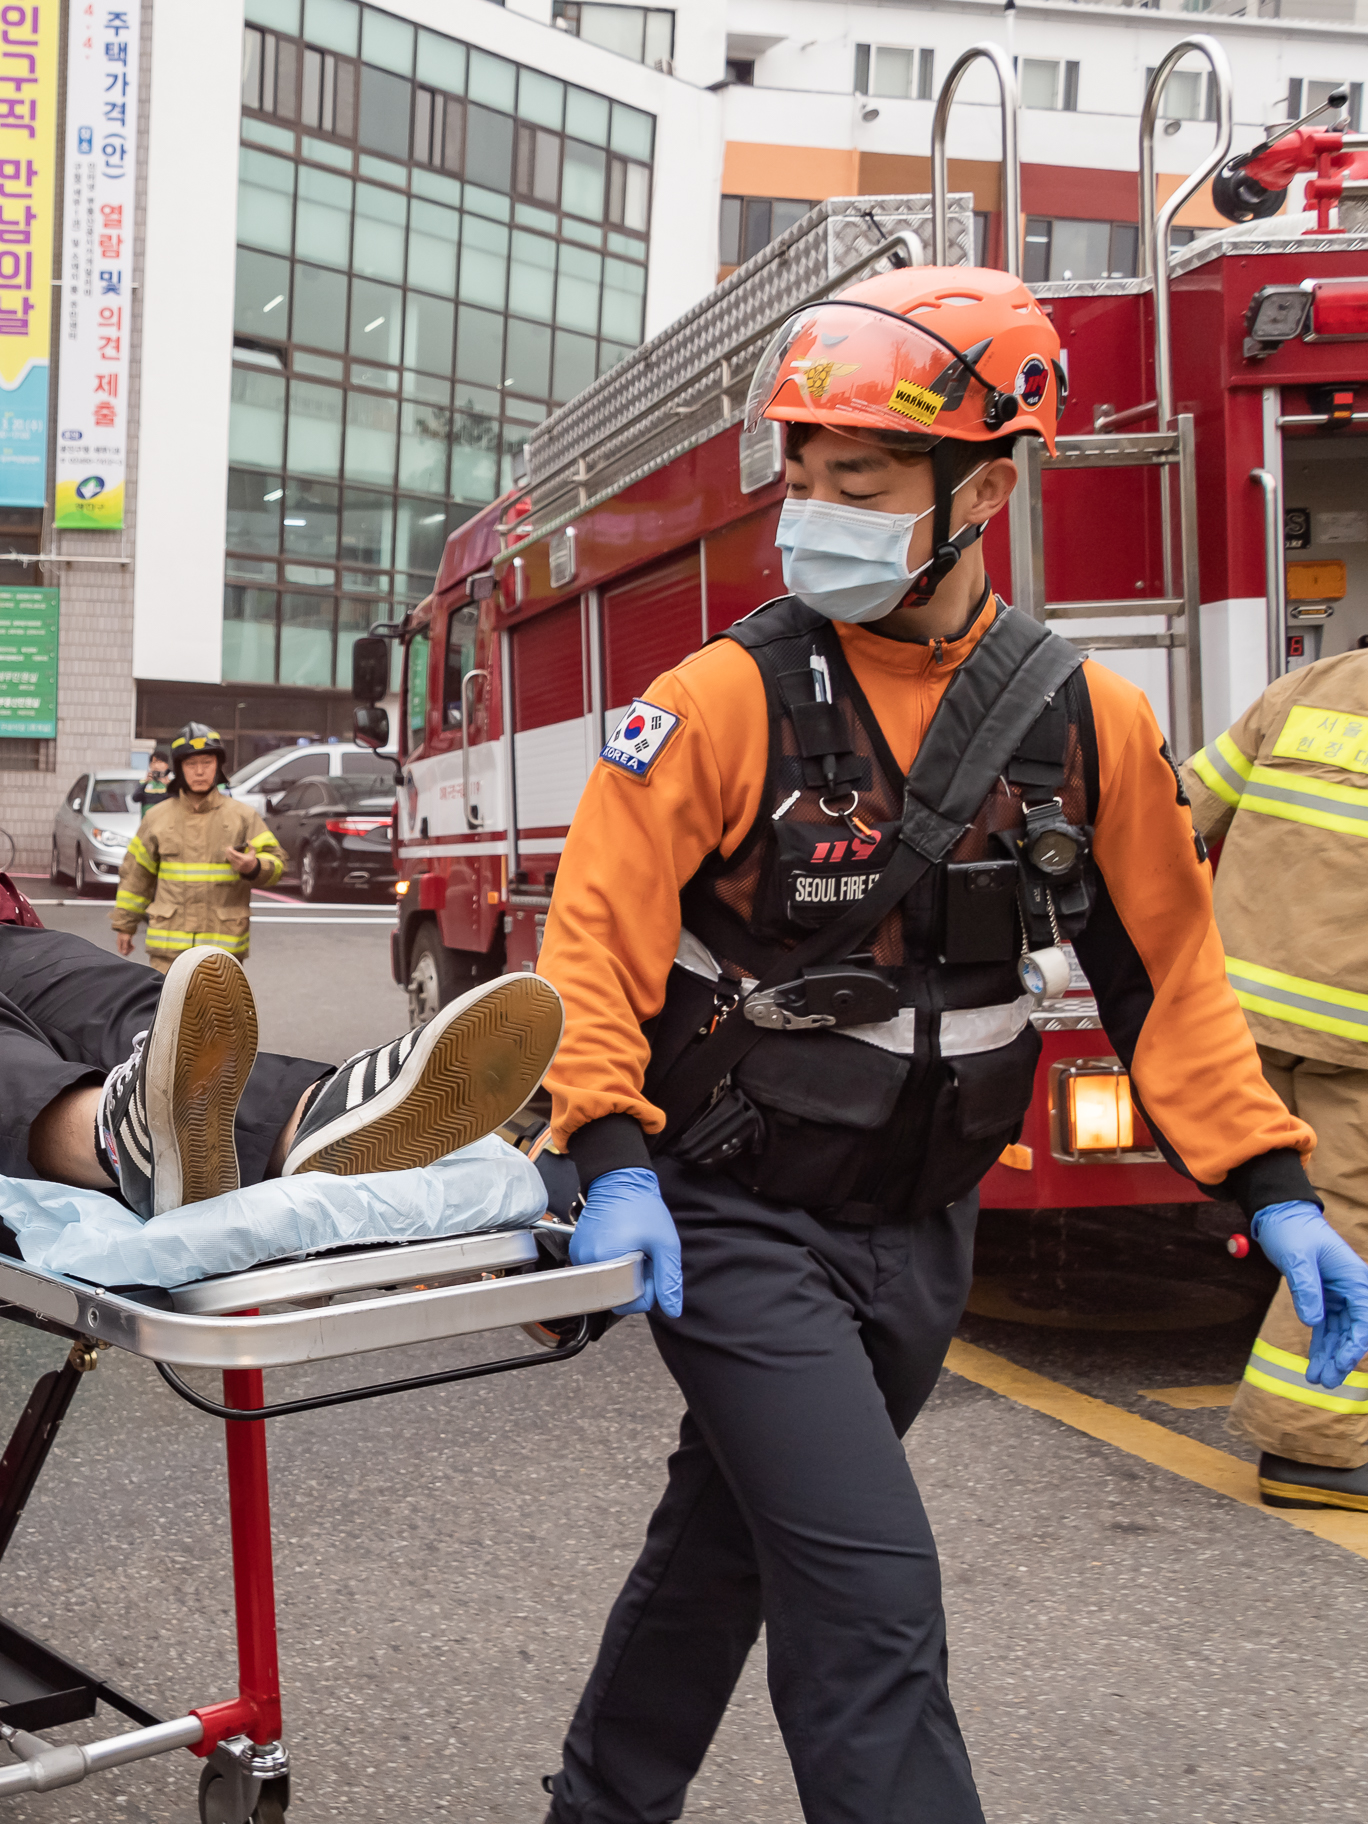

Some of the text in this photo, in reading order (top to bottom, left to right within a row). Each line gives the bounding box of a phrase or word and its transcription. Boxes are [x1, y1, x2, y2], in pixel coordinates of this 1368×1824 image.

[98, 203, 124, 259] 열람
[99, 269, 123, 296] 및
[97, 305, 123, 363] 의견
[92, 371, 119, 428] 제출
[895, 389, 938, 416] WARNING
[602, 746, 639, 770] KOREA
[810, 830, 882, 863] 119
[795, 877, 837, 902] SEOUL
[839, 875, 867, 901] FIRE
